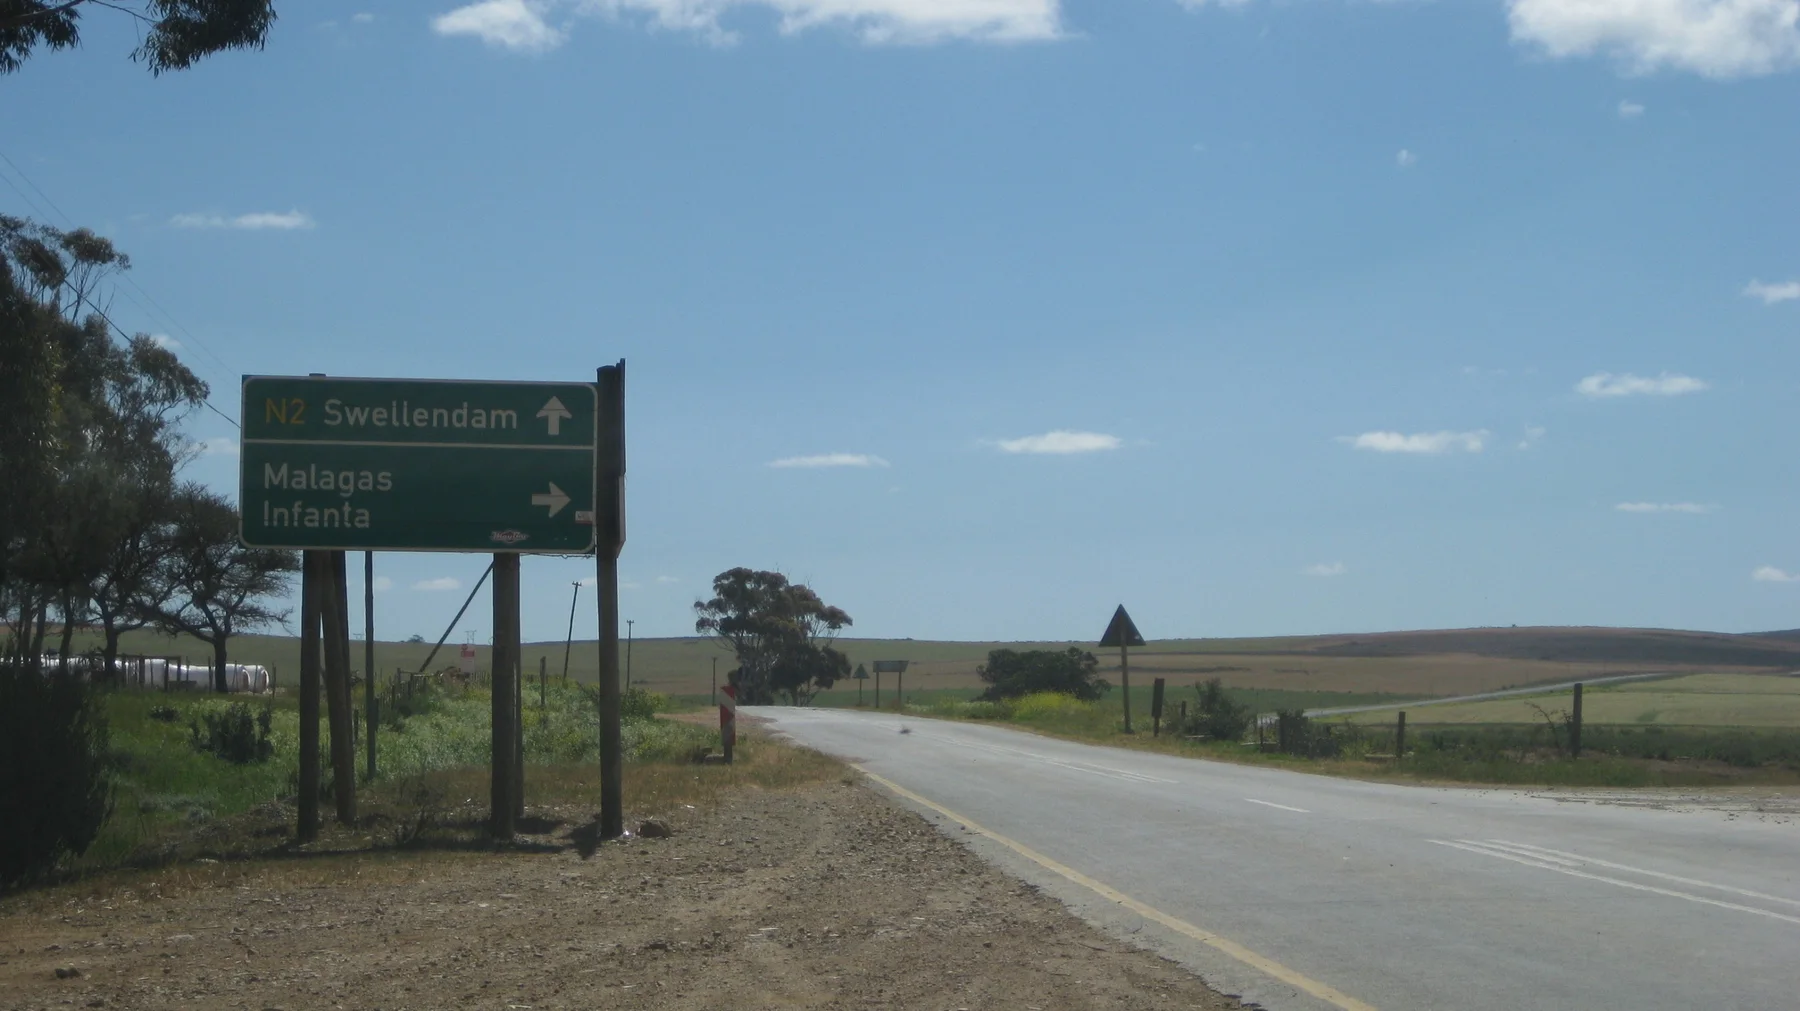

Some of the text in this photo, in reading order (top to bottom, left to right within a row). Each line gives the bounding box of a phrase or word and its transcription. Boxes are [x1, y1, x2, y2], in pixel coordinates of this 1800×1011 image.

[265, 398, 518, 429] N2 Swellendam
[264, 463, 393, 498] Malagas
[263, 500, 370, 529] Infanta
